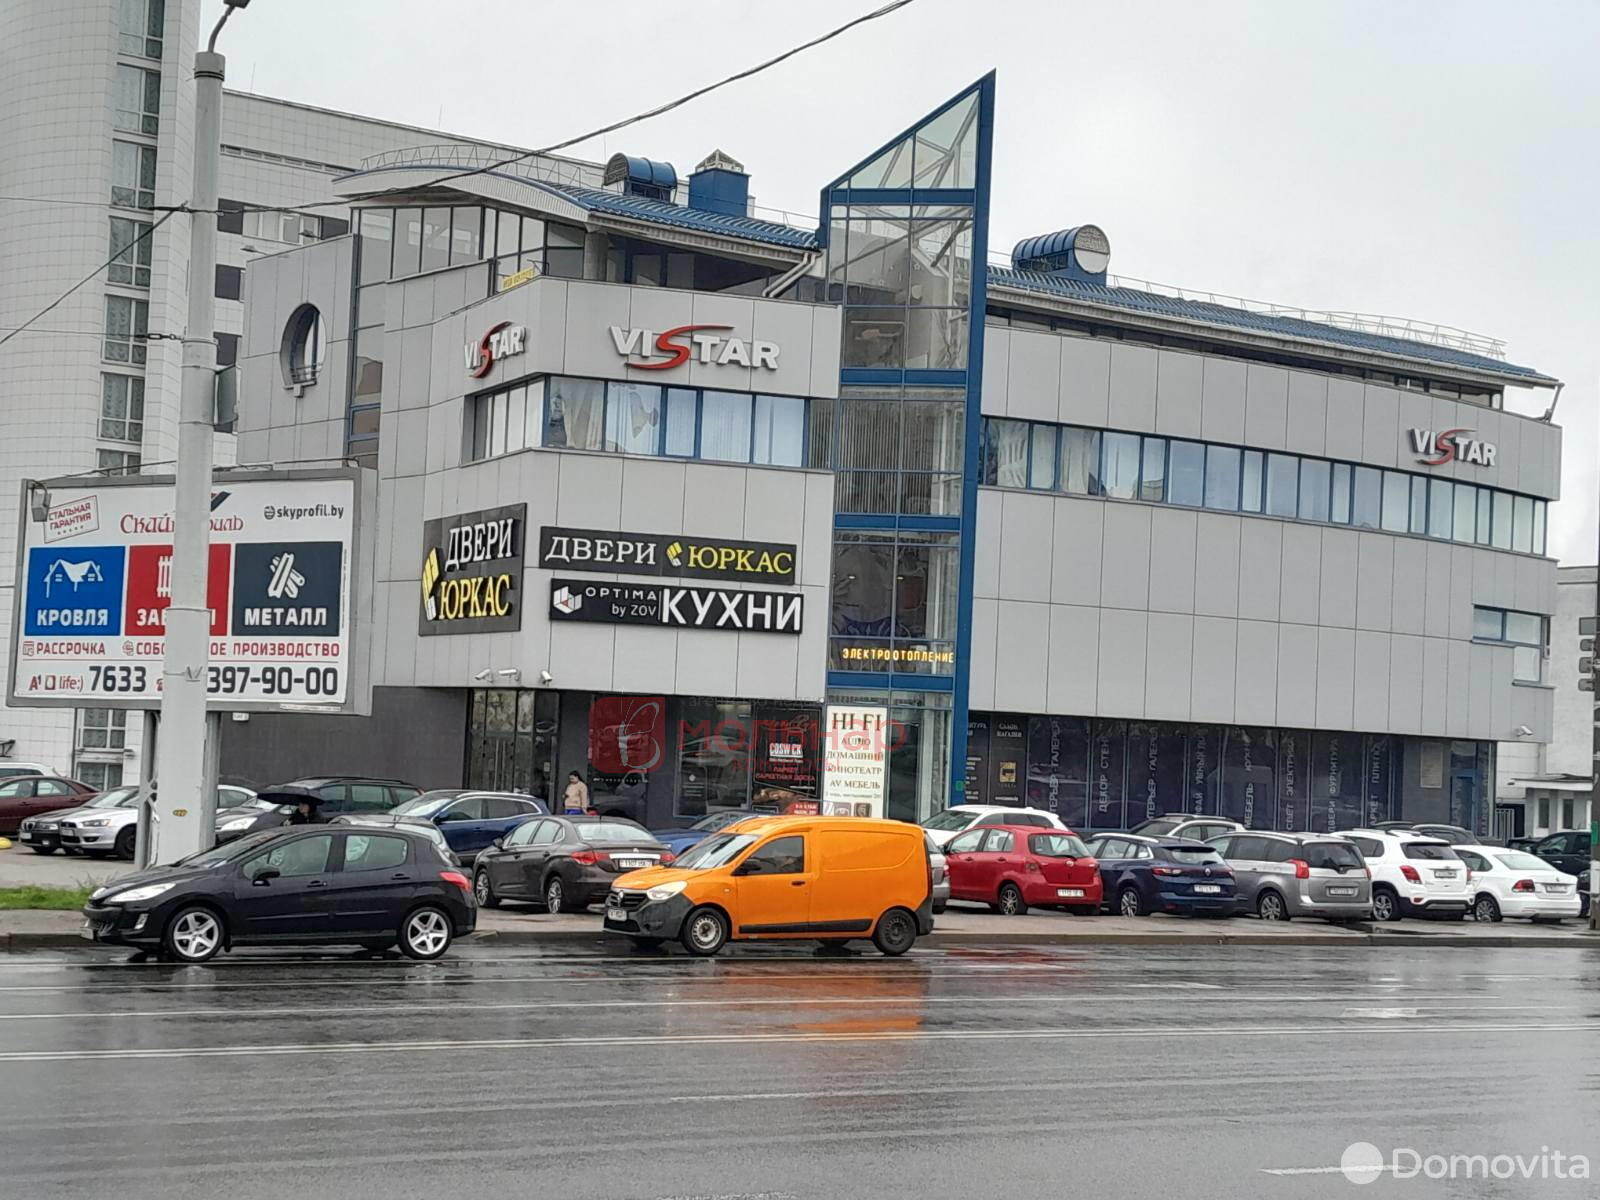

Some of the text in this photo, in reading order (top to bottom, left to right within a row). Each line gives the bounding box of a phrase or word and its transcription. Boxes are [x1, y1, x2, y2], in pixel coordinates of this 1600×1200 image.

[464, 321, 526, 378] VISTAR
[609, 324, 780, 370] VISTAR
[1411, 428, 1497, 466] VISTAR
[48, 502, 91, 521] СТАЛЬНАЯ
[50, 512, 92, 530] ГАРАНТИЯ
[445, 518, 514, 571] ДВЕРИ
[545, 536, 792, 574] ДВЕРИ ЮРКАС
[439, 575, 511, 620] ЮРКАС
[585, 587, 657, 601] OPTIMA
[36, 608, 109, 627] КРОВЛЯ
[244, 607, 327, 627] МЕТАЛЛ
[612, 603, 656, 617] by ZOV
[662, 589, 801, 632] КУХНИ
[36, 642, 106, 655] РАССРОЧКА
[233, 642, 340, 658] ПРОИЗВОДСТВО
[842, 647, 954, 663] ЭЛЕКТРООТОПЛЕНИЕ
[89, 665, 147, 692] 7633
[207, 666, 338, 695] 397-90-00
[826, 750, 884, 761] ДОМАШНИЙ
[845, 780, 881, 789] МЕБЕЛЬ
